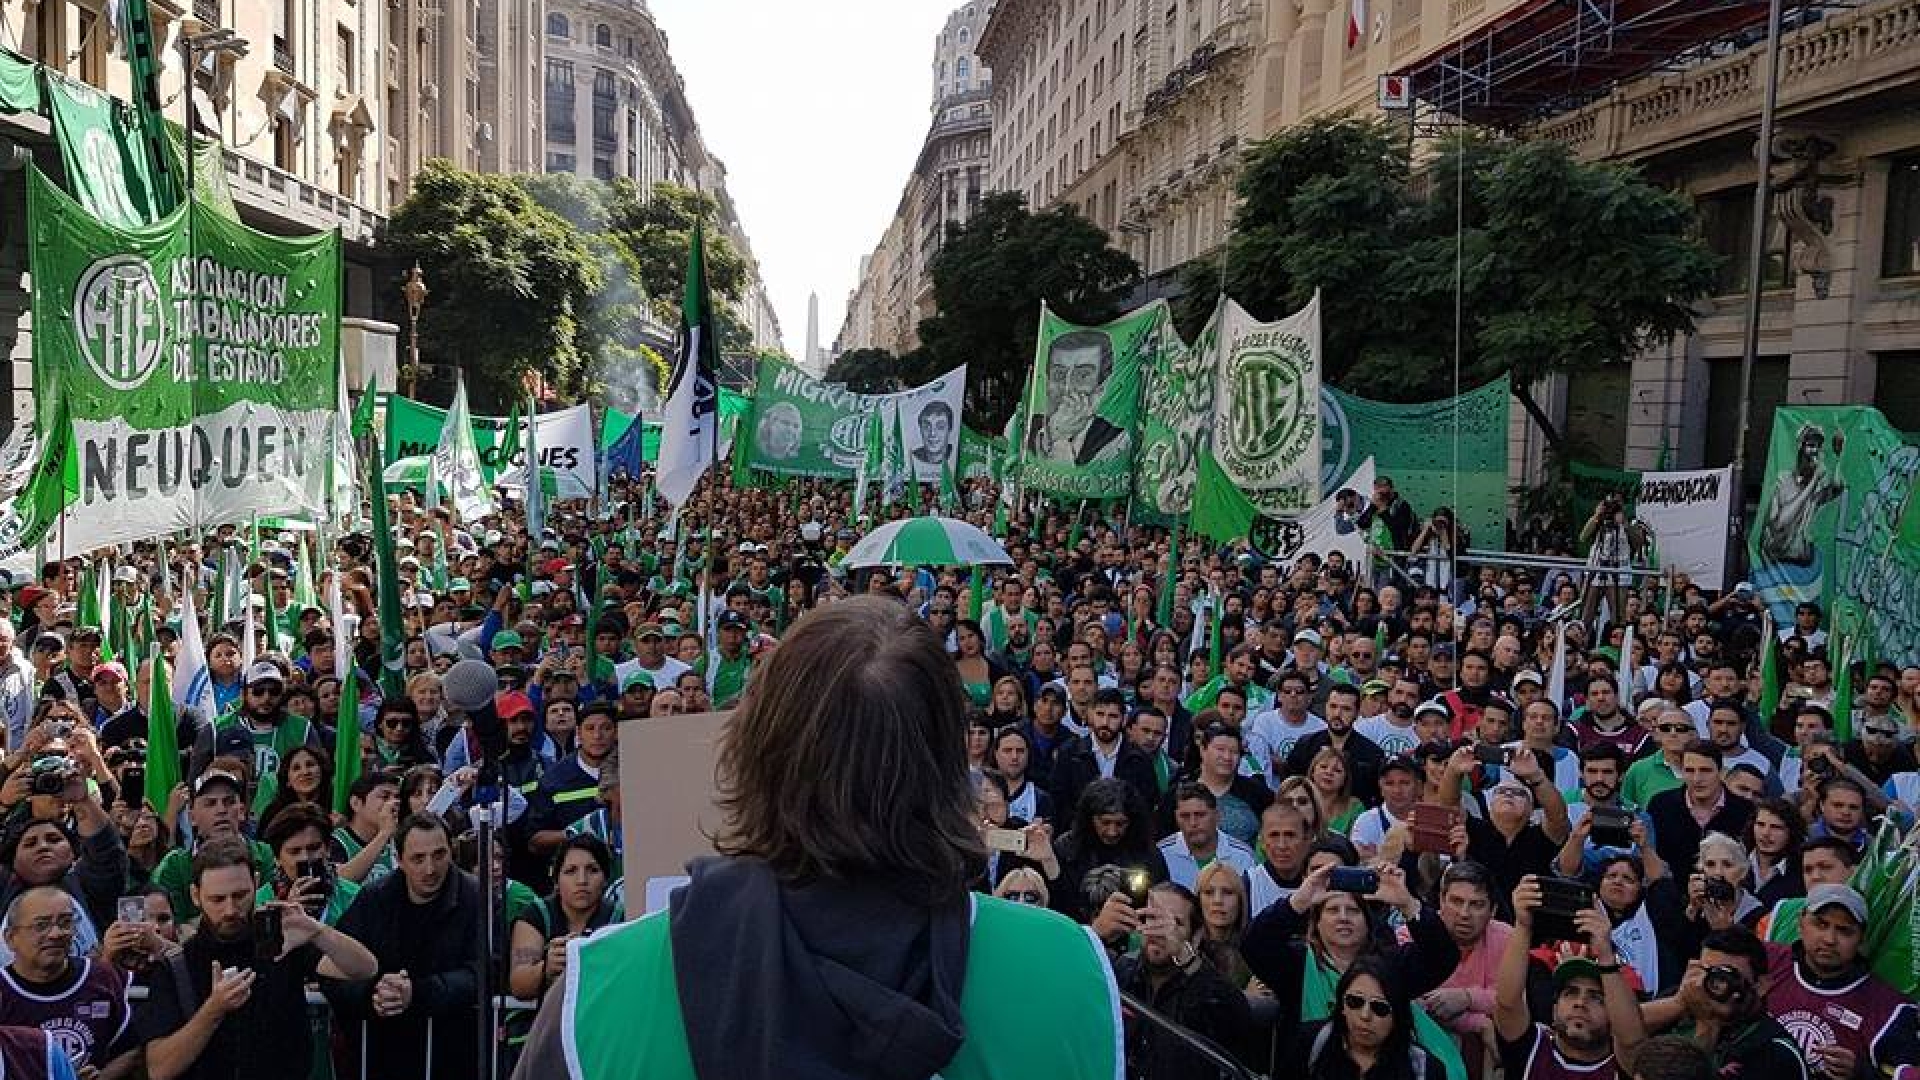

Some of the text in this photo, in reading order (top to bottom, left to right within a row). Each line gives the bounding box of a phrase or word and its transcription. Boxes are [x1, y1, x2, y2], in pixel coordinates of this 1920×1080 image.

[173, 342, 285, 385] DEL ESTADO
[83, 424, 309, 506] NEUQUEN
